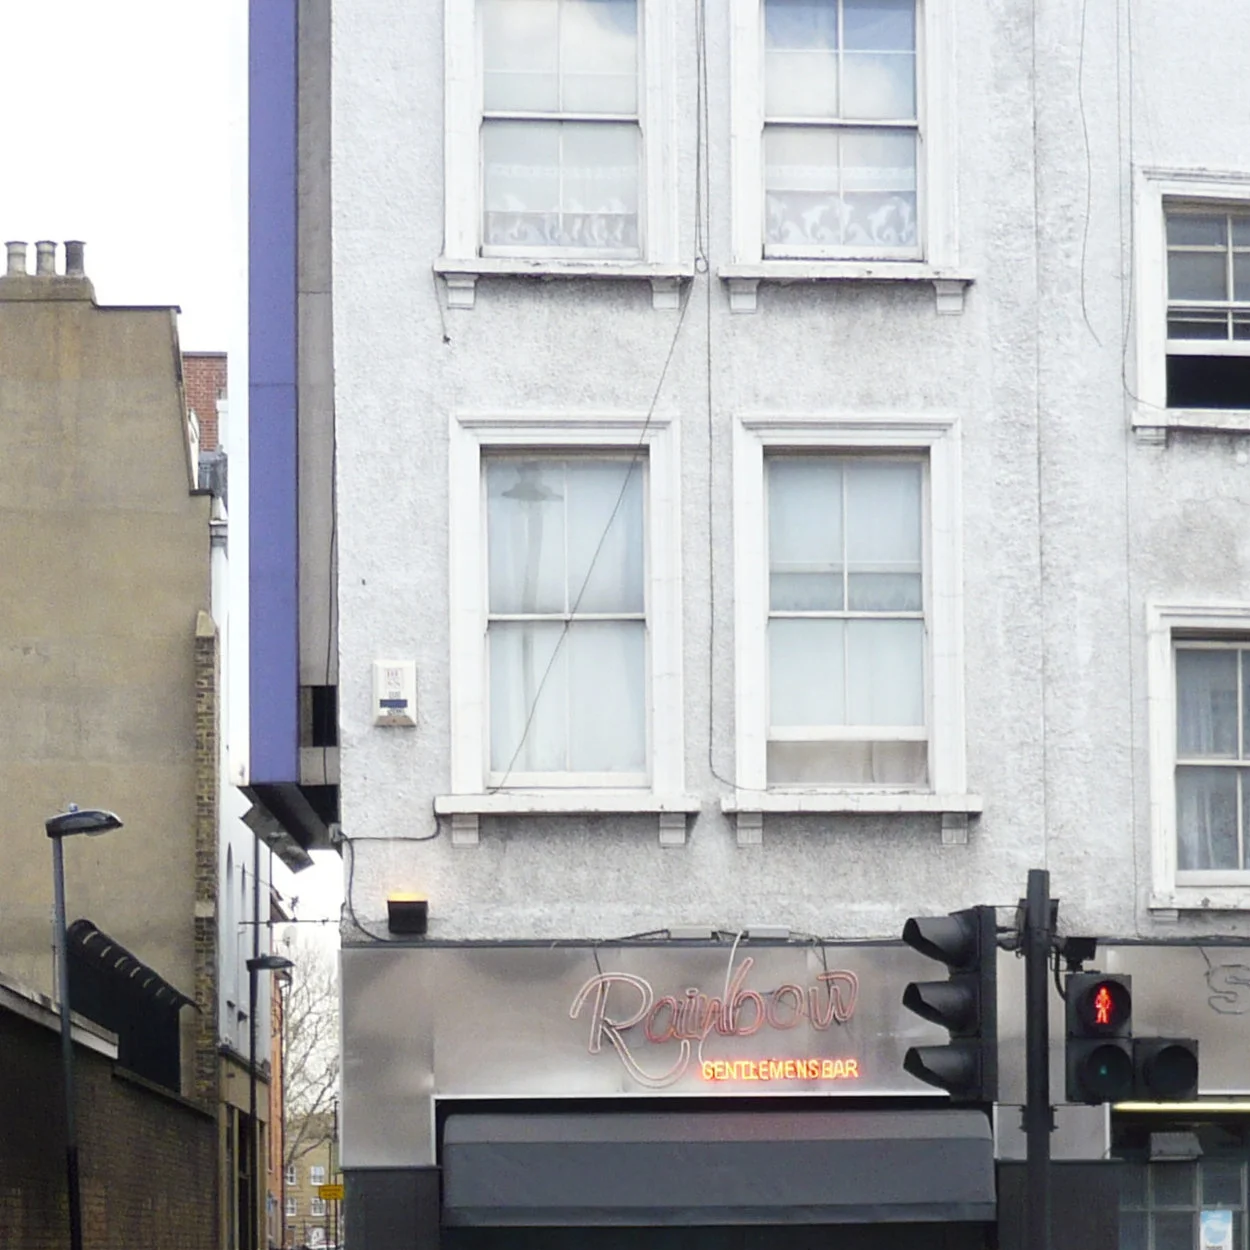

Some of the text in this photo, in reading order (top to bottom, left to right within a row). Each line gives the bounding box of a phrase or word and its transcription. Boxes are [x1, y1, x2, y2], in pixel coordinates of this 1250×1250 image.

[569, 956, 859, 1089] Rainbow
[701, 1058, 859, 1081] GENTLEMENS BAR
